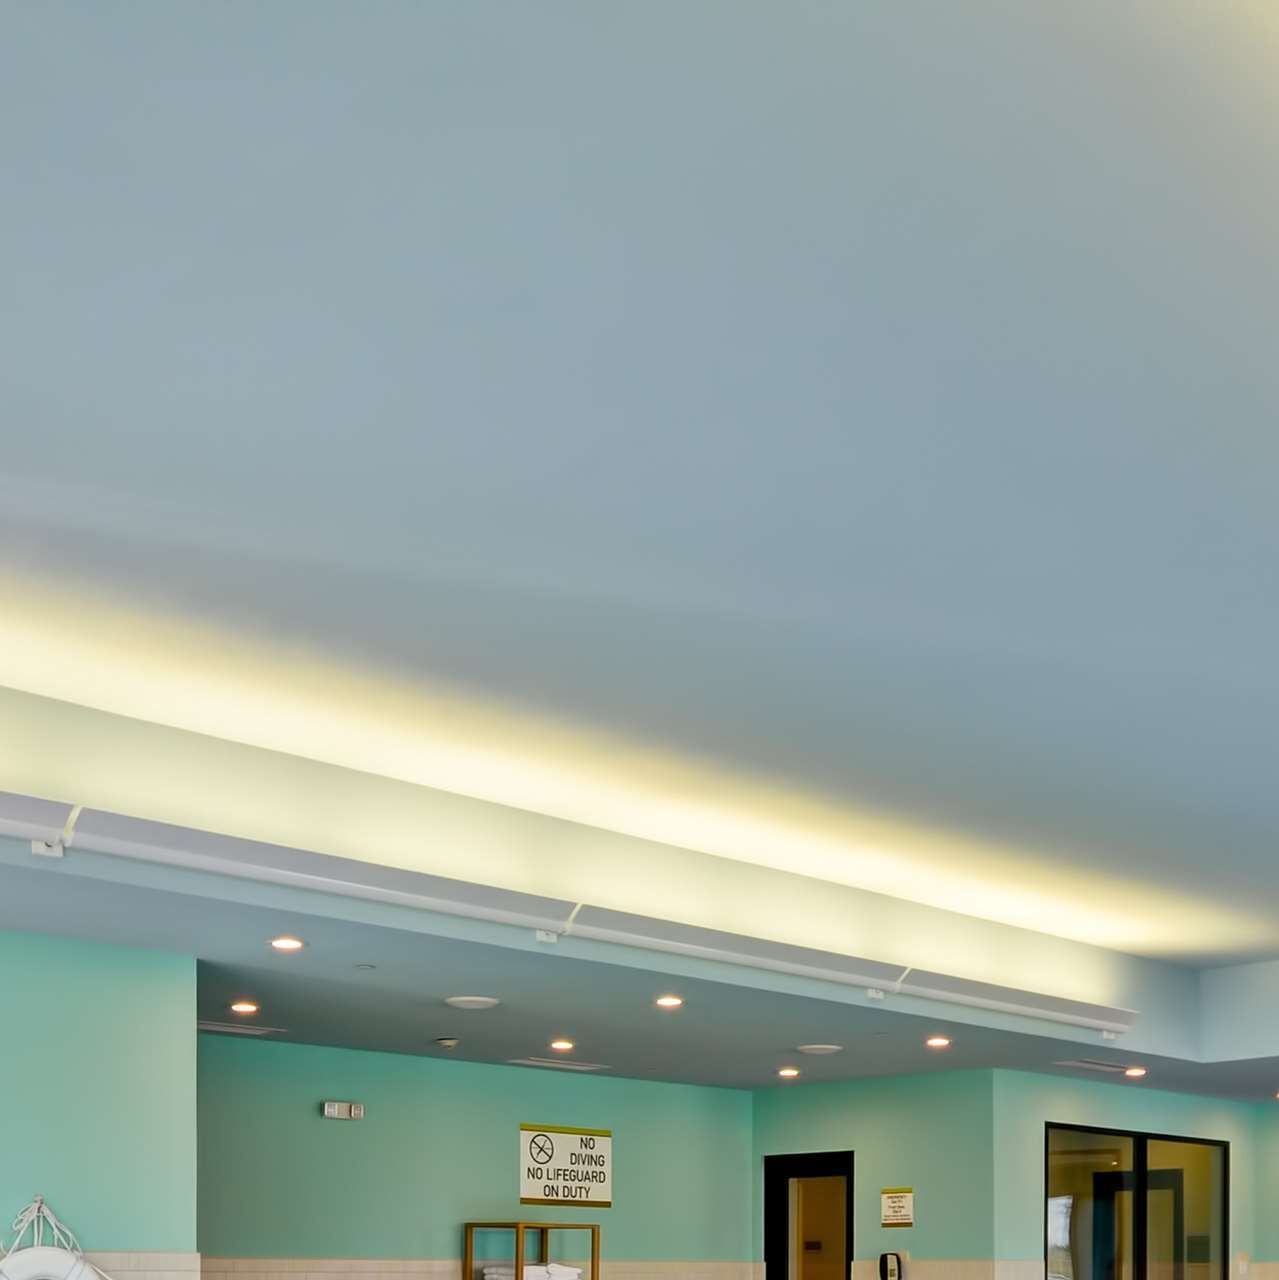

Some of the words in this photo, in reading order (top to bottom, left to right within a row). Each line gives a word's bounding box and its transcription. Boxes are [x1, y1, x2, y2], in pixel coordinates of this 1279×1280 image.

[580, 1137, 596, 1150] NO
[570, 1152, 605, 1167] DIVING
[527, 1166, 543, 1180] NO
[546, 1167, 606, 1183] LIFEGUARD
[543, 1184, 559, 1197] ON
[562, 1185, 591, 1199] DUTY
